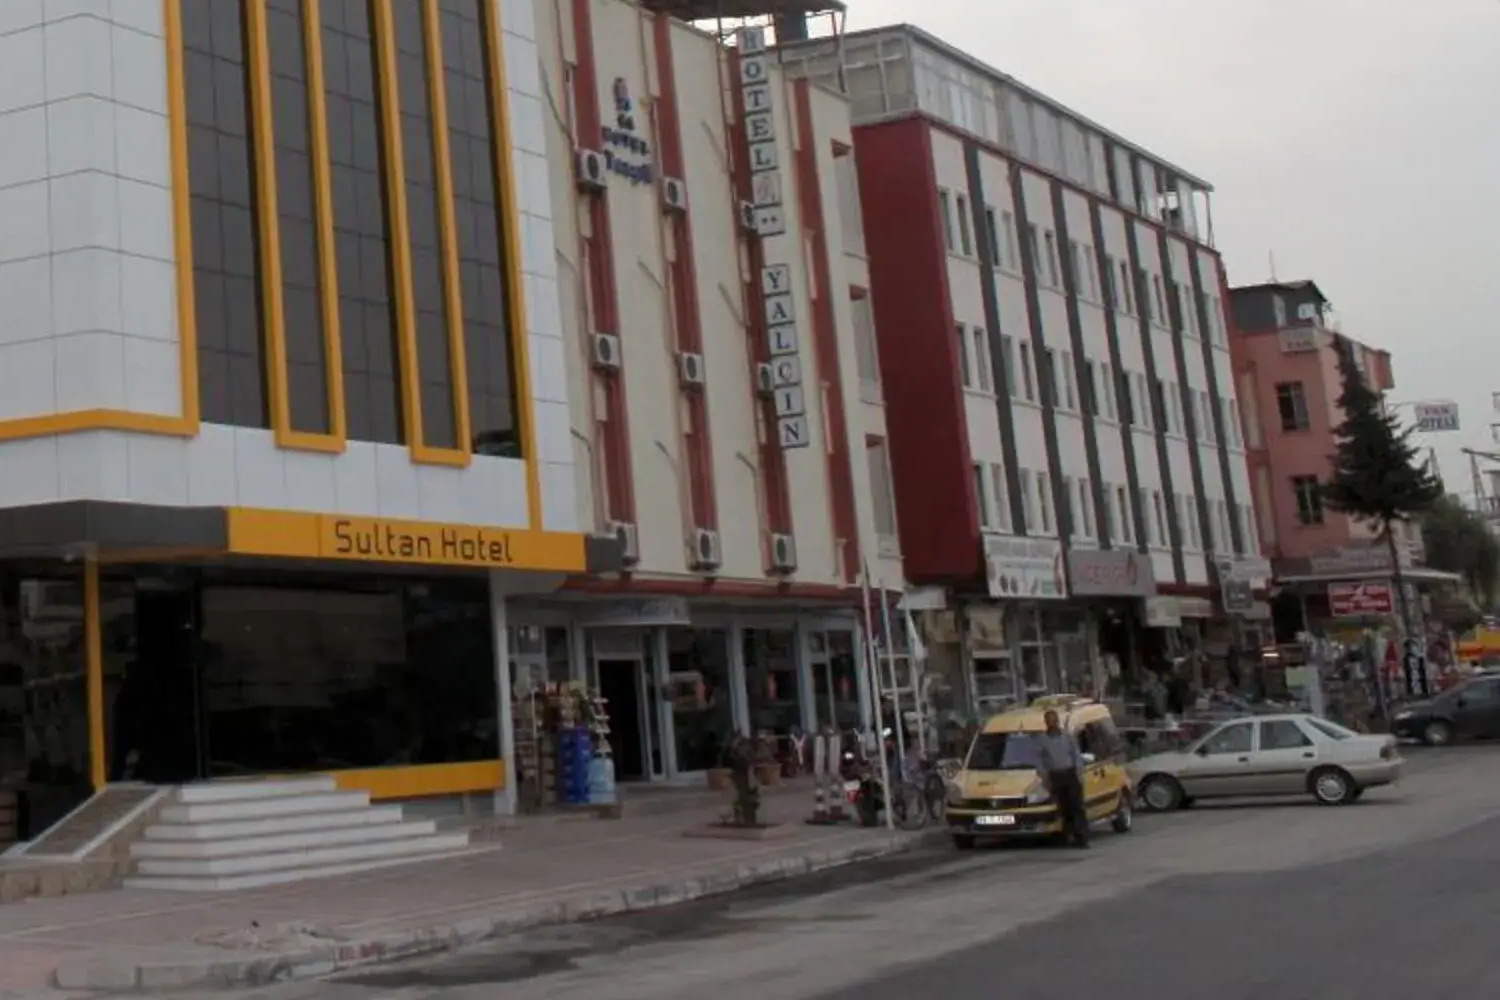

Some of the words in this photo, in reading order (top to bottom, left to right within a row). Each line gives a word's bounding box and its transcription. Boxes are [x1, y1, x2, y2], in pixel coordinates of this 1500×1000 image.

[743, 29, 772, 167] HOTEL
[335, 520, 432, 559] Sultan
[441, 528, 514, 563] Hotel
